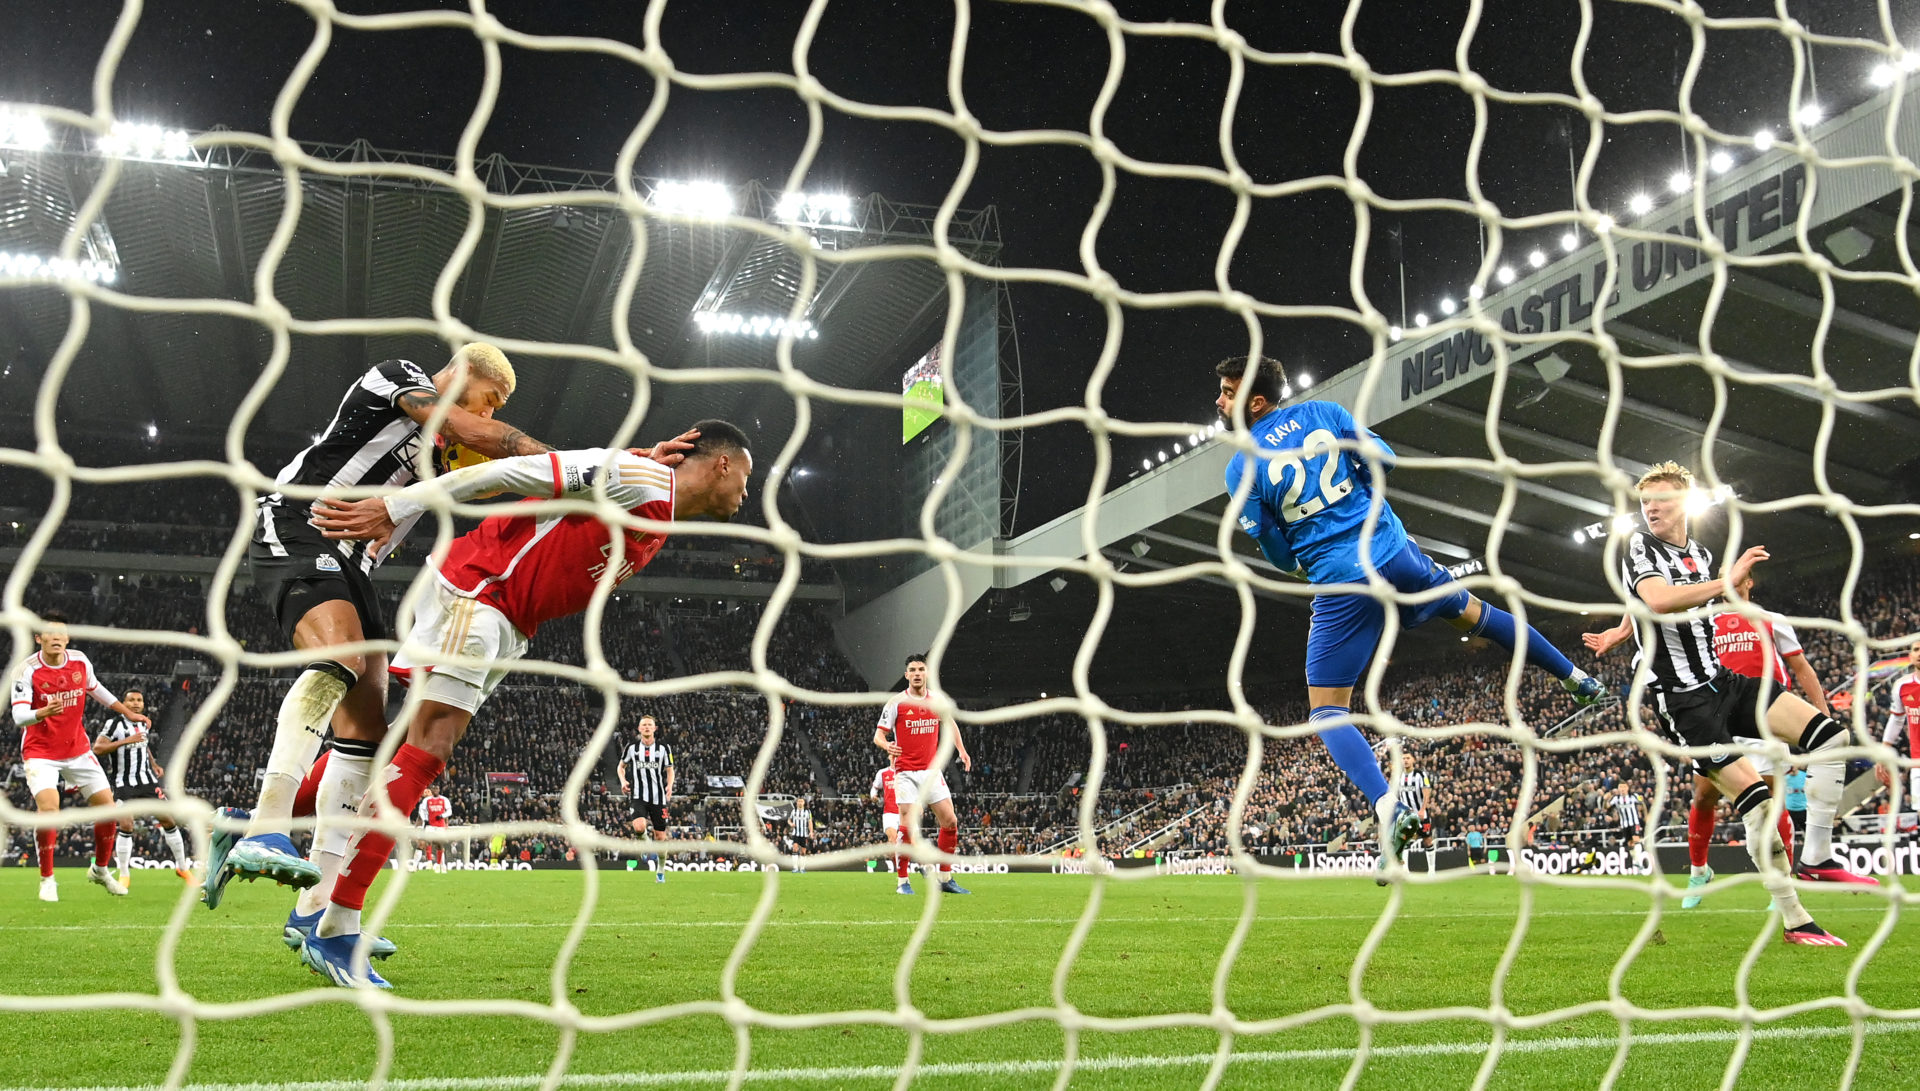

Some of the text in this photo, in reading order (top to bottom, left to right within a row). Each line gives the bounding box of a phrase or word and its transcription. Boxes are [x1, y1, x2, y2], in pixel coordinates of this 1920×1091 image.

[1401, 254, 1619, 402] NEWCASTLE
[1265, 419, 1302, 446] RAYA
[1268, 428, 1353, 523] 22
[1713, 631, 1761, 646] mirates
[305, 726, 324, 740] NU
[1317, 853, 1382, 874] Sportsb
